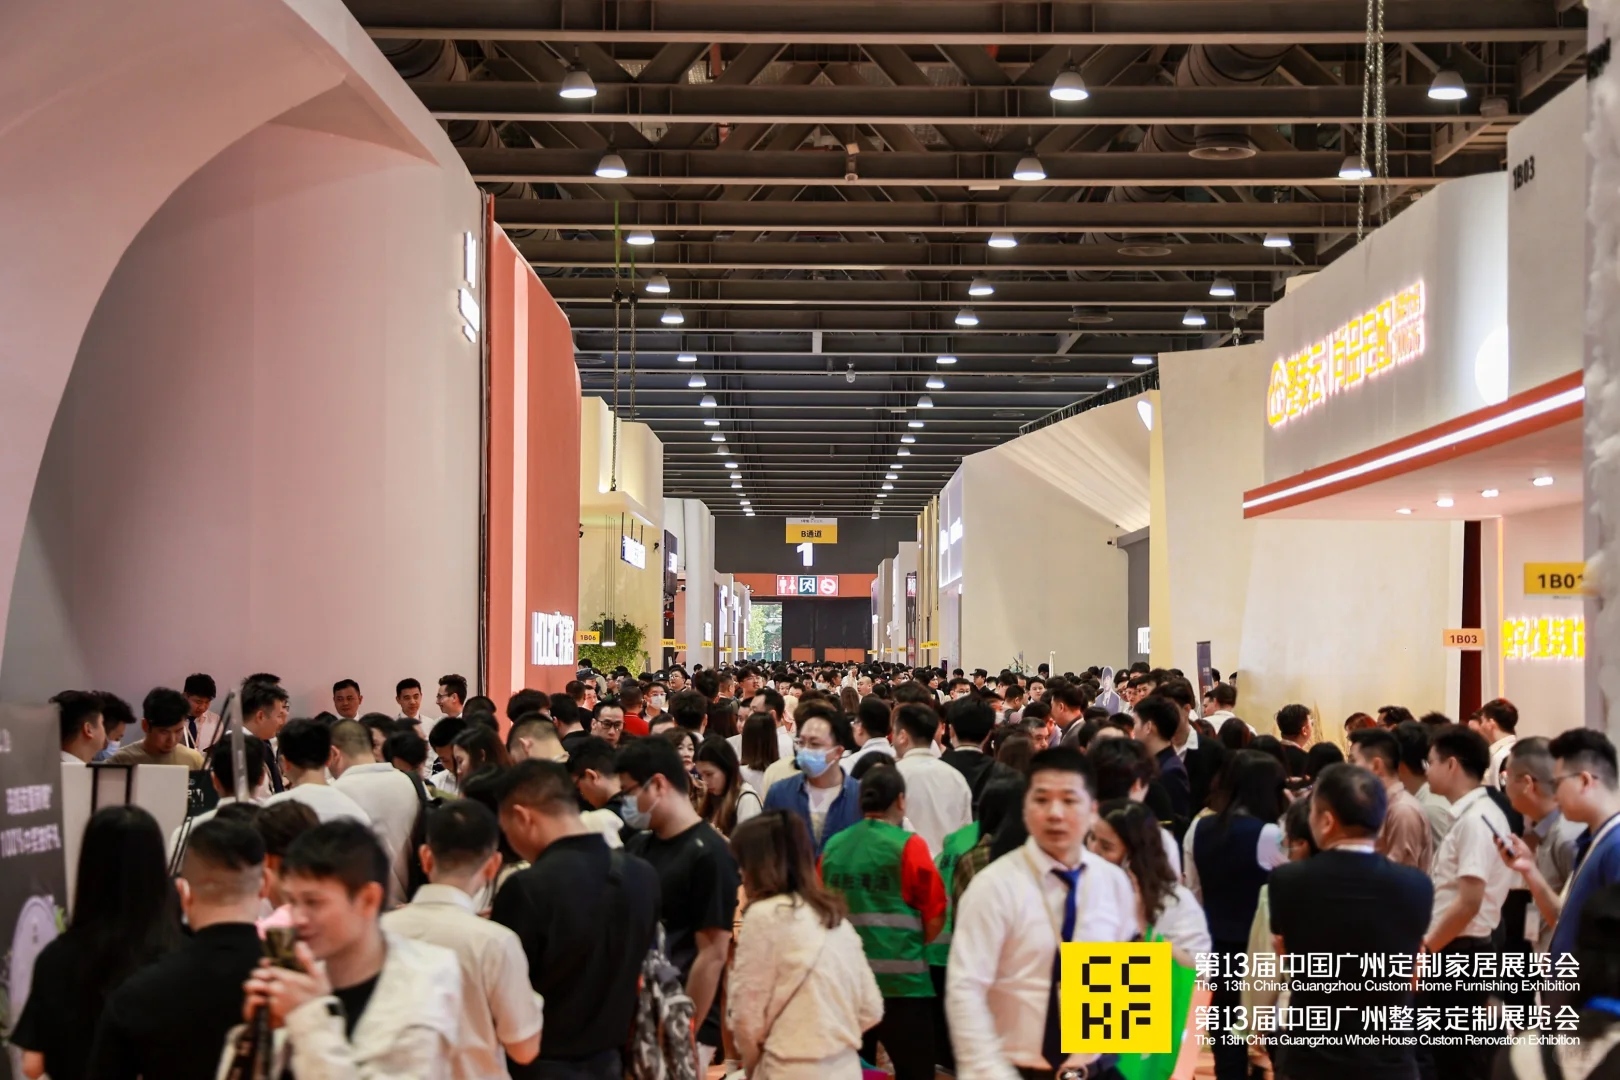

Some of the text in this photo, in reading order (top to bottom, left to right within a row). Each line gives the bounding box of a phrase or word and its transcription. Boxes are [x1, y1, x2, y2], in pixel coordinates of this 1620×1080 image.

[1513, 154, 1535, 192] 1B03
[801, 529, 822, 538] B通道
[796, 542, 813, 567] 1
[1450, 634, 1478, 644] 1B03
